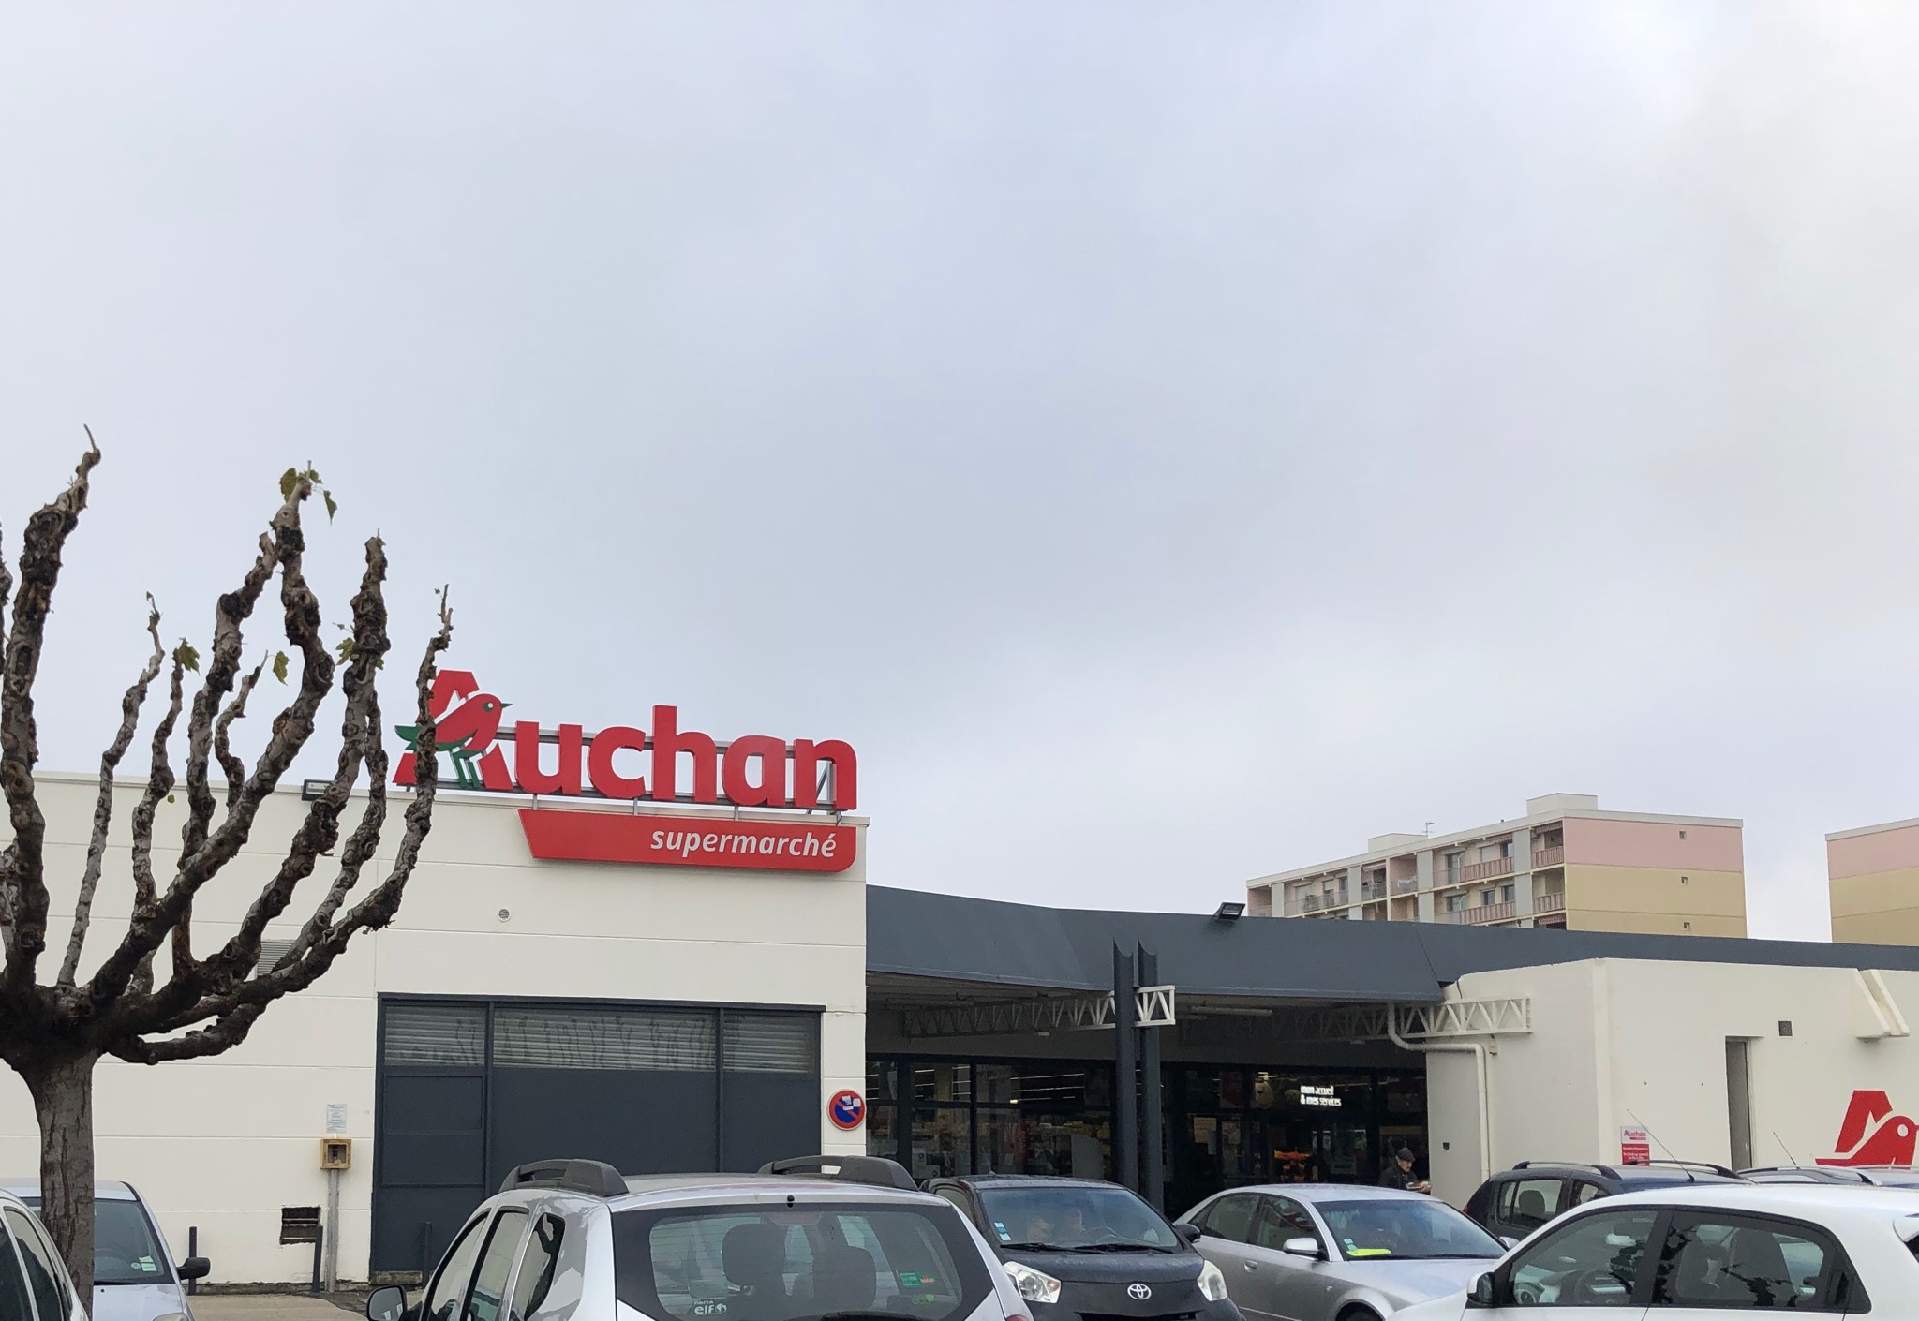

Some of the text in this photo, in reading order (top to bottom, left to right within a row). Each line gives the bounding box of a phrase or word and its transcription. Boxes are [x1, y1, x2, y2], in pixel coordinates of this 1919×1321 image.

[393, 669, 857, 810] Auchan
[650, 829, 837, 858] supermarché
[694, 1304, 715, 1315] elf
